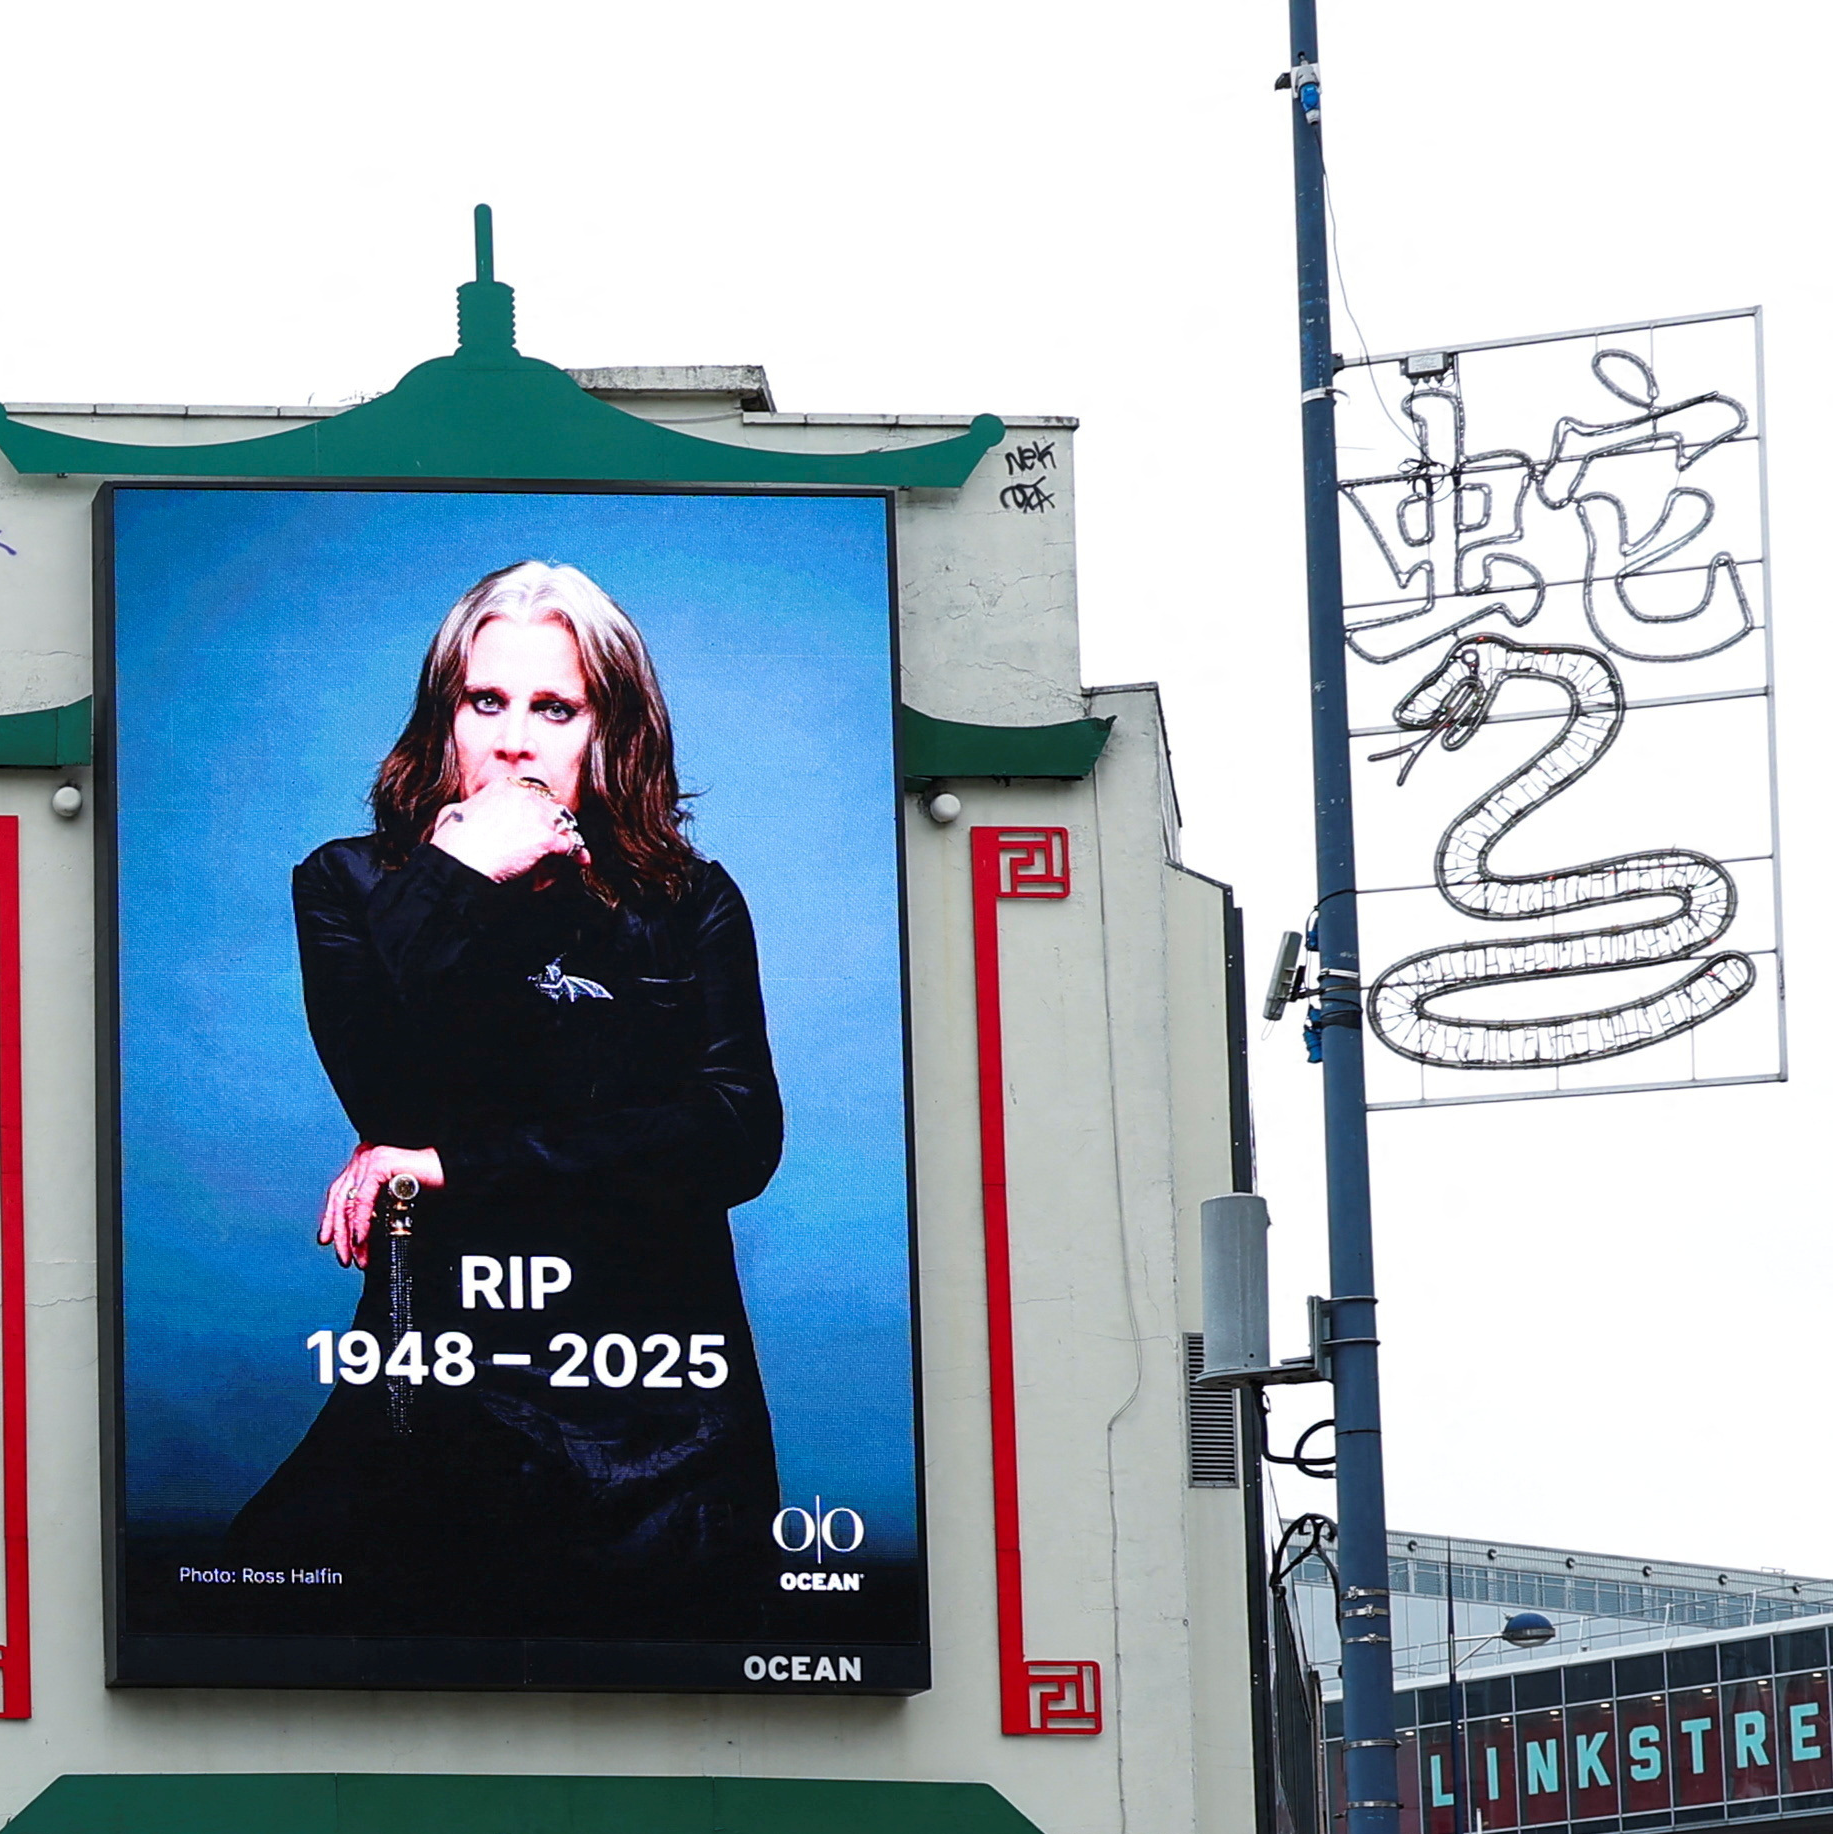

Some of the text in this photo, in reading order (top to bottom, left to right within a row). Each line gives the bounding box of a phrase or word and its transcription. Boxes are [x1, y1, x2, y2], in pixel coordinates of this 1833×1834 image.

[461, 1255, 573, 1311] RIP
[306, 1329, 476, 1387] 1948
[549, 1333, 729, 1390] 2025
[179, 1566, 343, 1585] Photo: Ross Halfin
[779, 1571, 861, 1592] OCEAN
[743, 1654, 863, 1683] OCEAN
